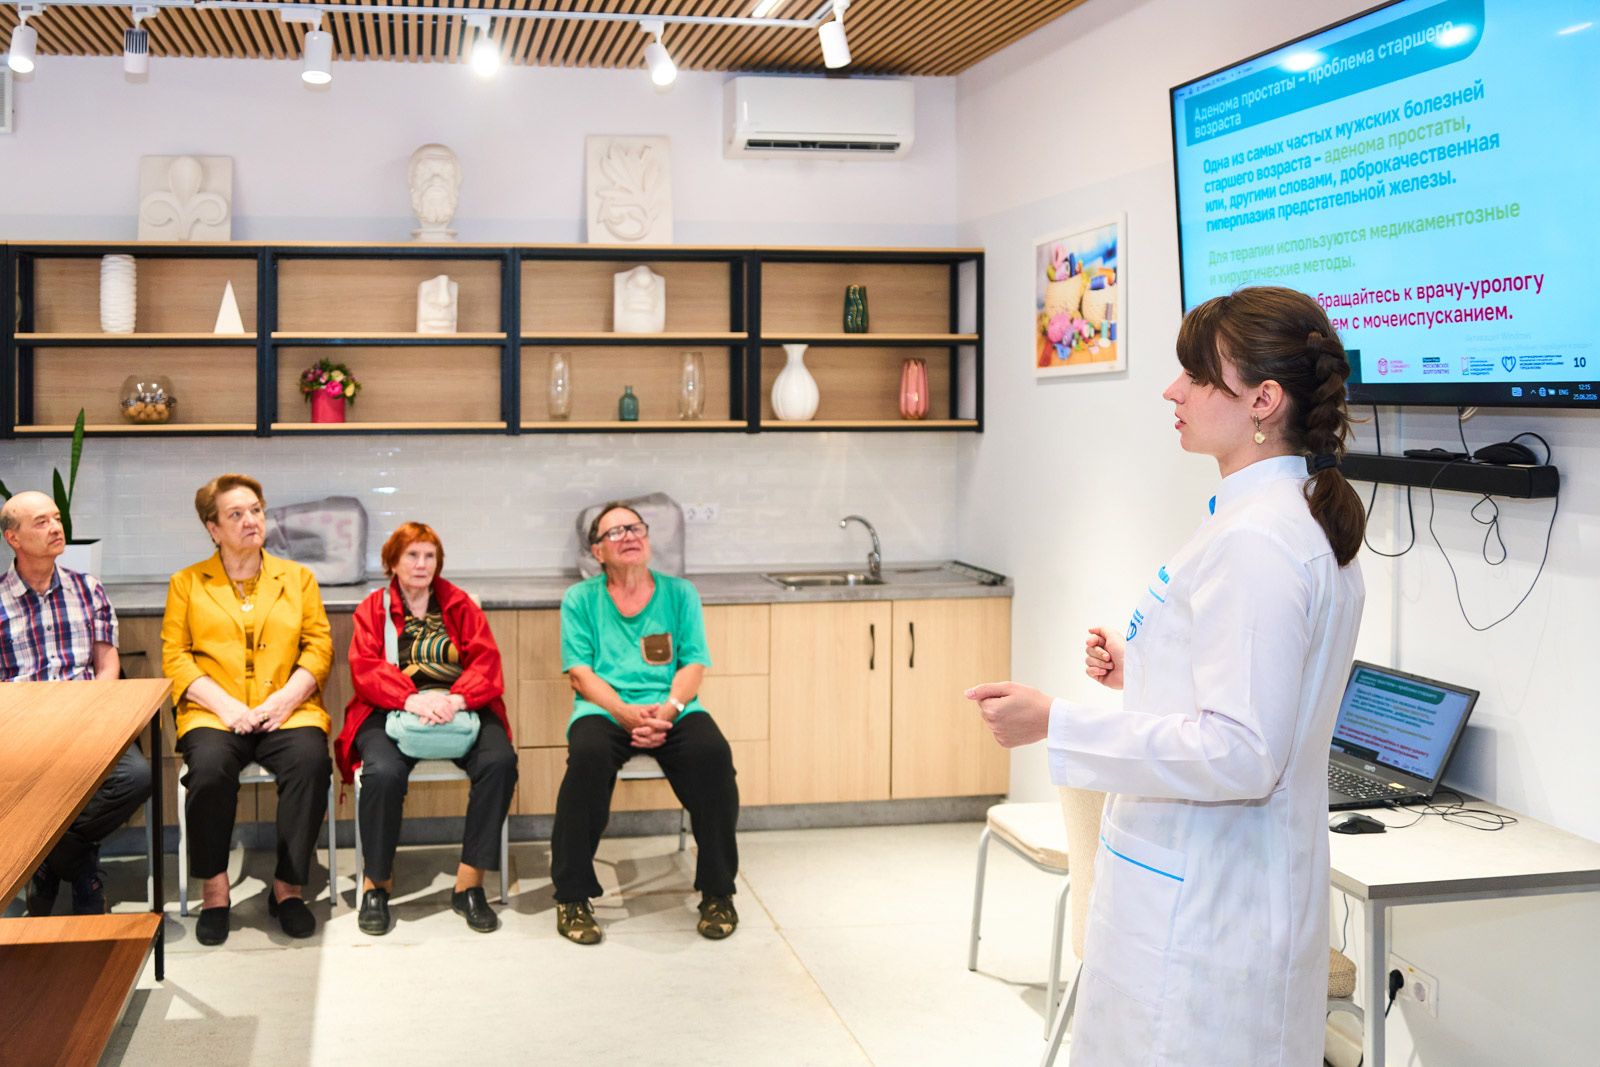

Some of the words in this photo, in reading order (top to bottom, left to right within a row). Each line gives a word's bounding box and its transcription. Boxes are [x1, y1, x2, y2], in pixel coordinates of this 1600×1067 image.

[1194, 96, 1240, 122] Аденома
[1241, 77, 1296, 108] простаты
[1308, 49, 1375, 85] проблема
[1195, 113, 1242, 139] возраста
[1203, 156, 1230, 174] Одна
[1232, 152, 1245, 167] из
[1247, 141, 1284, 163] самых
[1286, 127, 1333, 151] частых
[1335, 107, 1401, 140] мужских
[1403, 78, 1485, 119] болезней
[1204, 170, 1254, 194] старшего
[1257, 155, 1312, 180] возраста
[1324, 136, 1385, 164] аденома
[1388, 116, 1471, 150] простаты,
[1205, 197, 1227, 213] или,
[1230, 186, 1277, 209] другими
[1279, 172, 1337, 196] словами,
[1340, 133, 1500, 185] доброкачественная
[1206, 206, 1276, 232] гиперплазия
[1278, 179, 1386, 221] предстательной
[1389, 170, 1457, 196] железы.
[1208, 250, 1229, 267] Для
[1230, 244, 1275, 264] терапии
[1277, 228, 1367, 255] используются
[1370, 202, 1521, 239] медикаментозные
[1209, 274, 1216, 285] и
[1218, 261, 1300, 286] хирургические
[1303, 255, 1356, 274] методы.
[1404, 287, 1413, 301] к
[1417, 273, 1545, 303] врачу-урологу
[1352, 316, 1360, 330] с
[1363, 305, 1514, 330] мочеиспусканием.
[1573, 356, 1587, 368] 10
[1558, 388, 1569, 396] ENG
